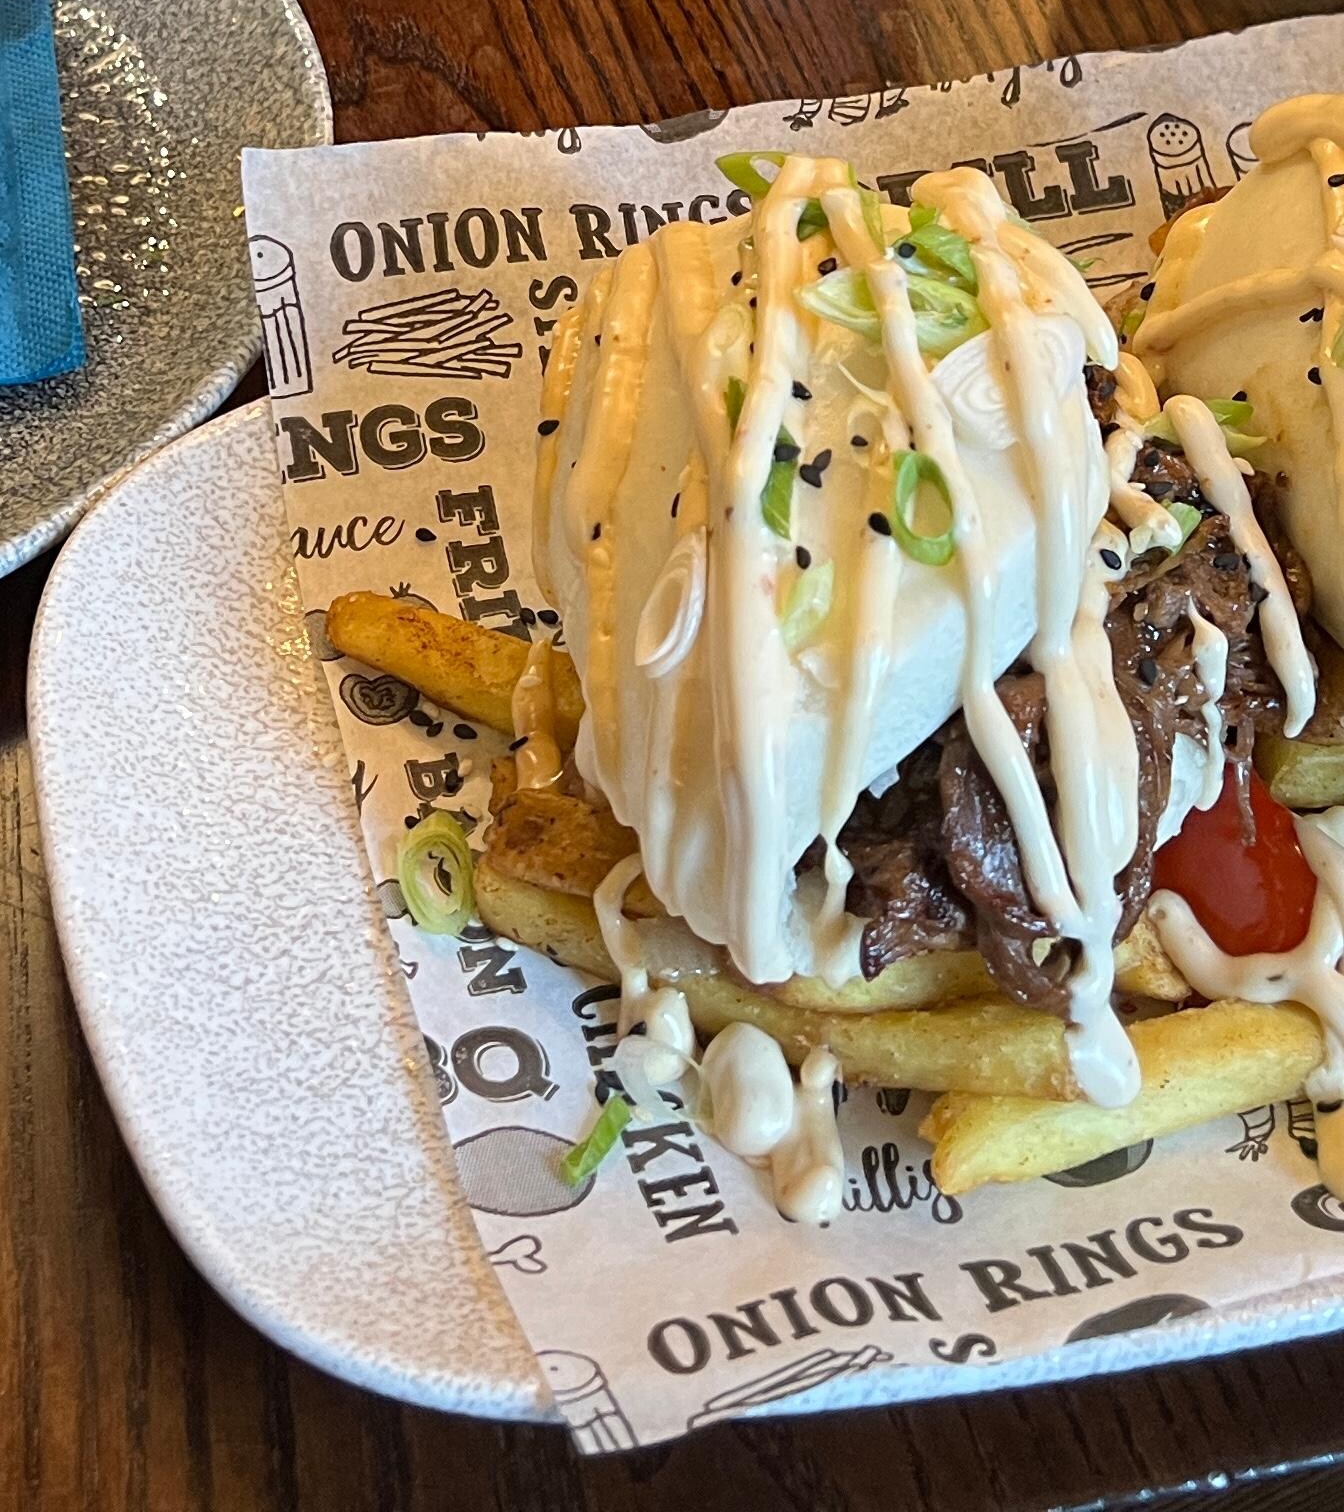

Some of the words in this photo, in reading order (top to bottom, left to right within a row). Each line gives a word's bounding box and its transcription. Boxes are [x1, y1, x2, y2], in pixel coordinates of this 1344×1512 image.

[328, 206, 548, 282] ONION
[647, 1273, 944, 1375] ONION
[958, 1207, 1244, 1314] RINGS
